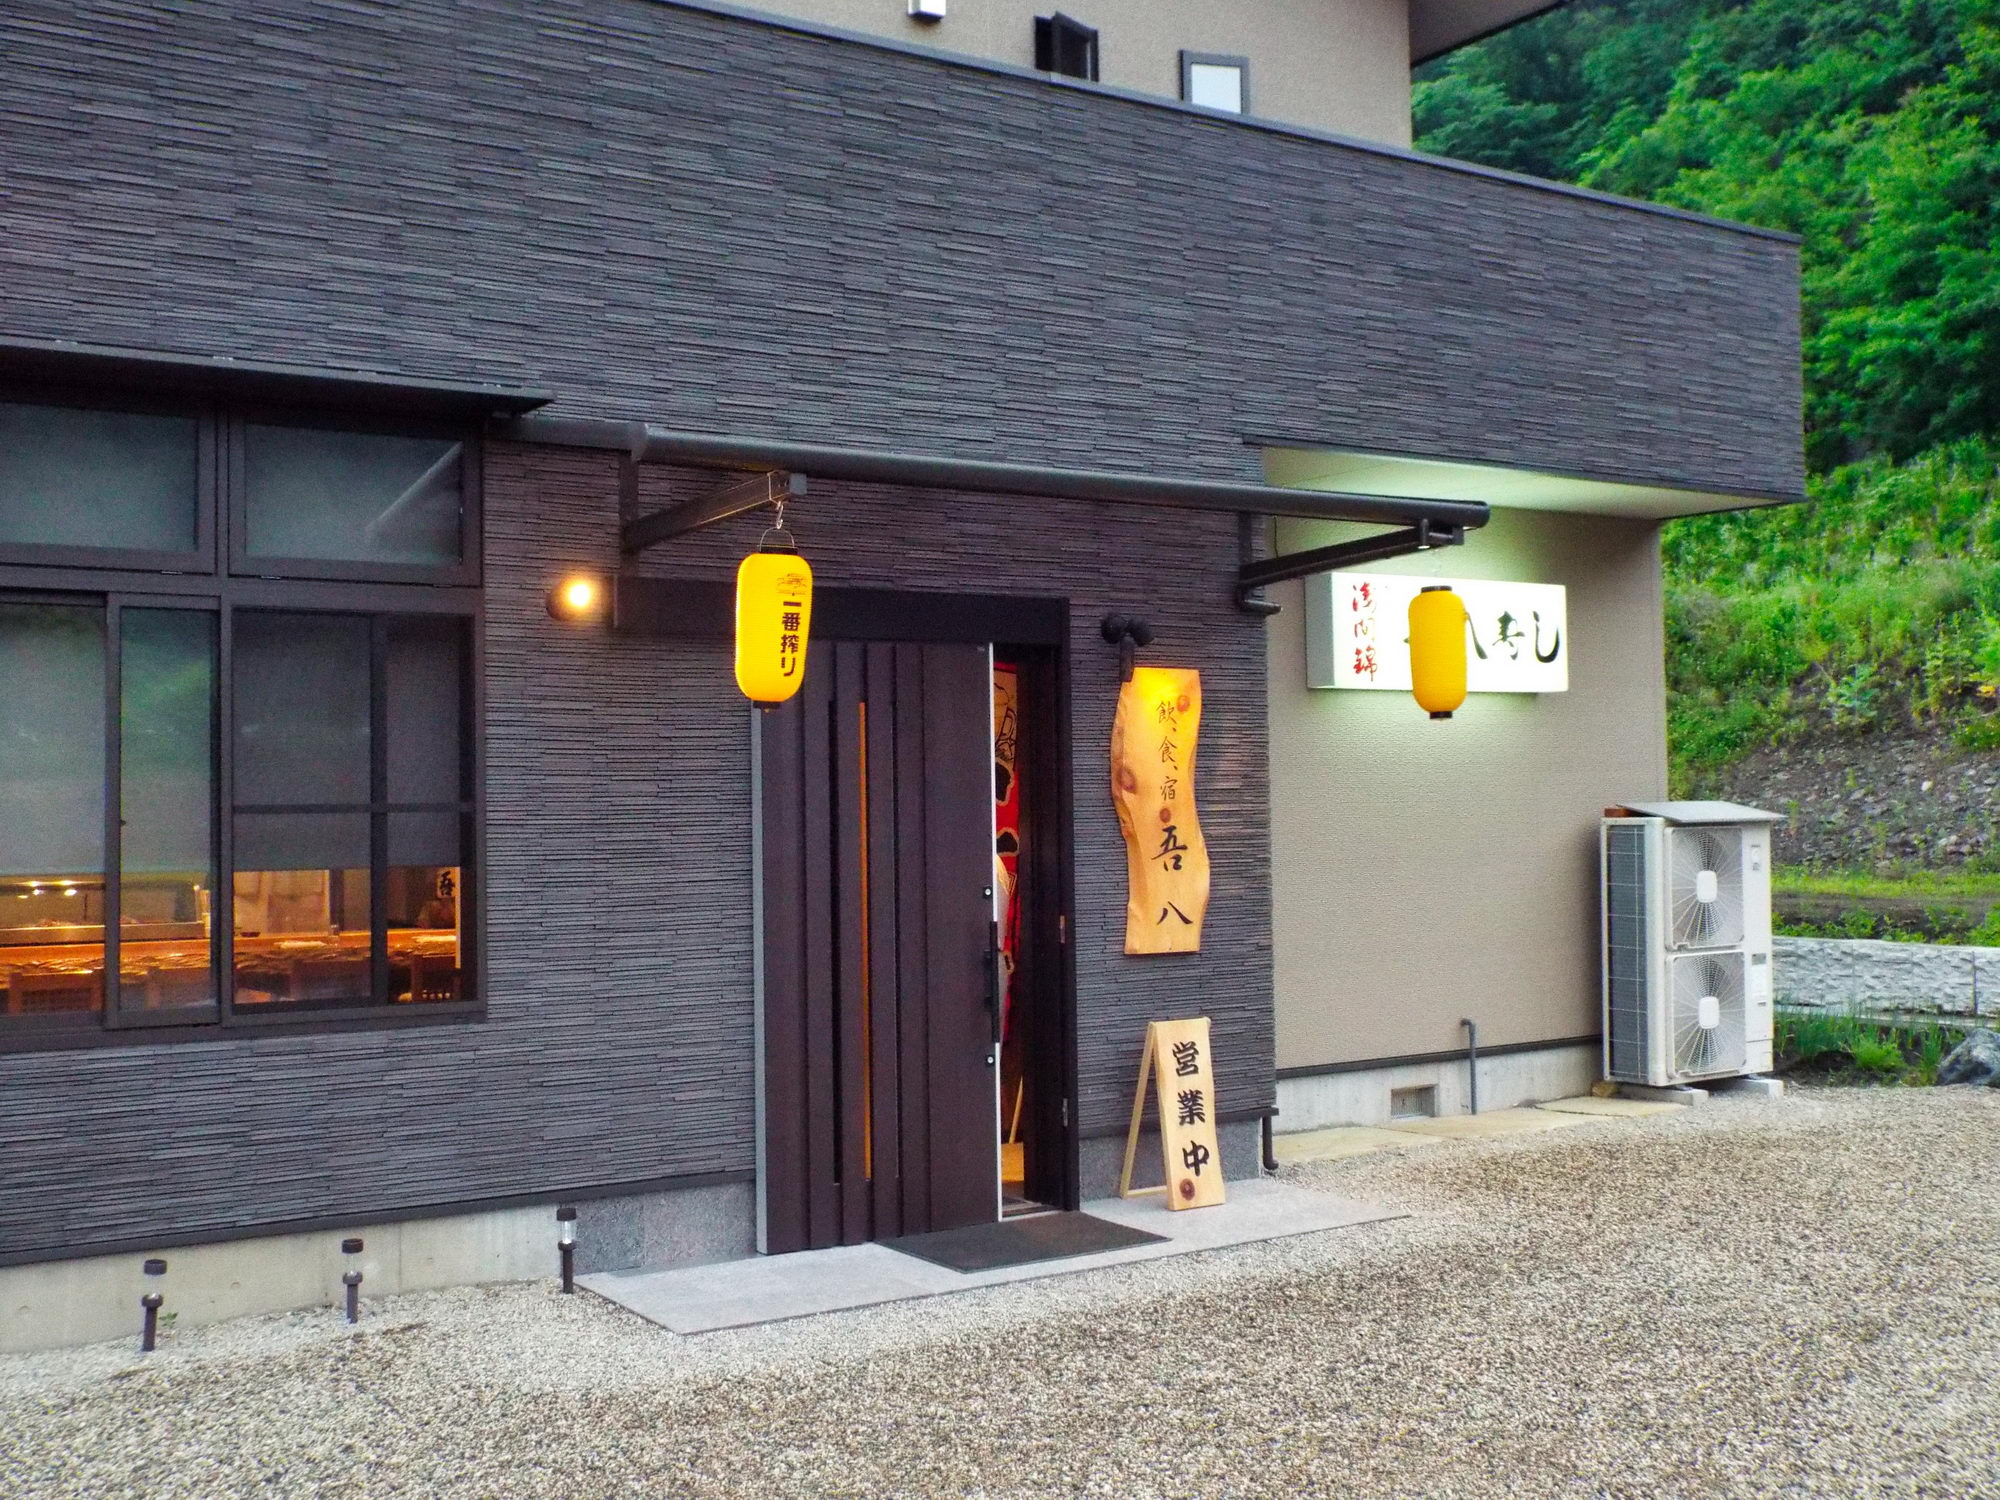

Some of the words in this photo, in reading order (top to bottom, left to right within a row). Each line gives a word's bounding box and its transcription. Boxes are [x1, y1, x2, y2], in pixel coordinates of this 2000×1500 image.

[780, 601, 802, 677] 一番搾り
[1172, 1041, 1210, 1177] 営業中
